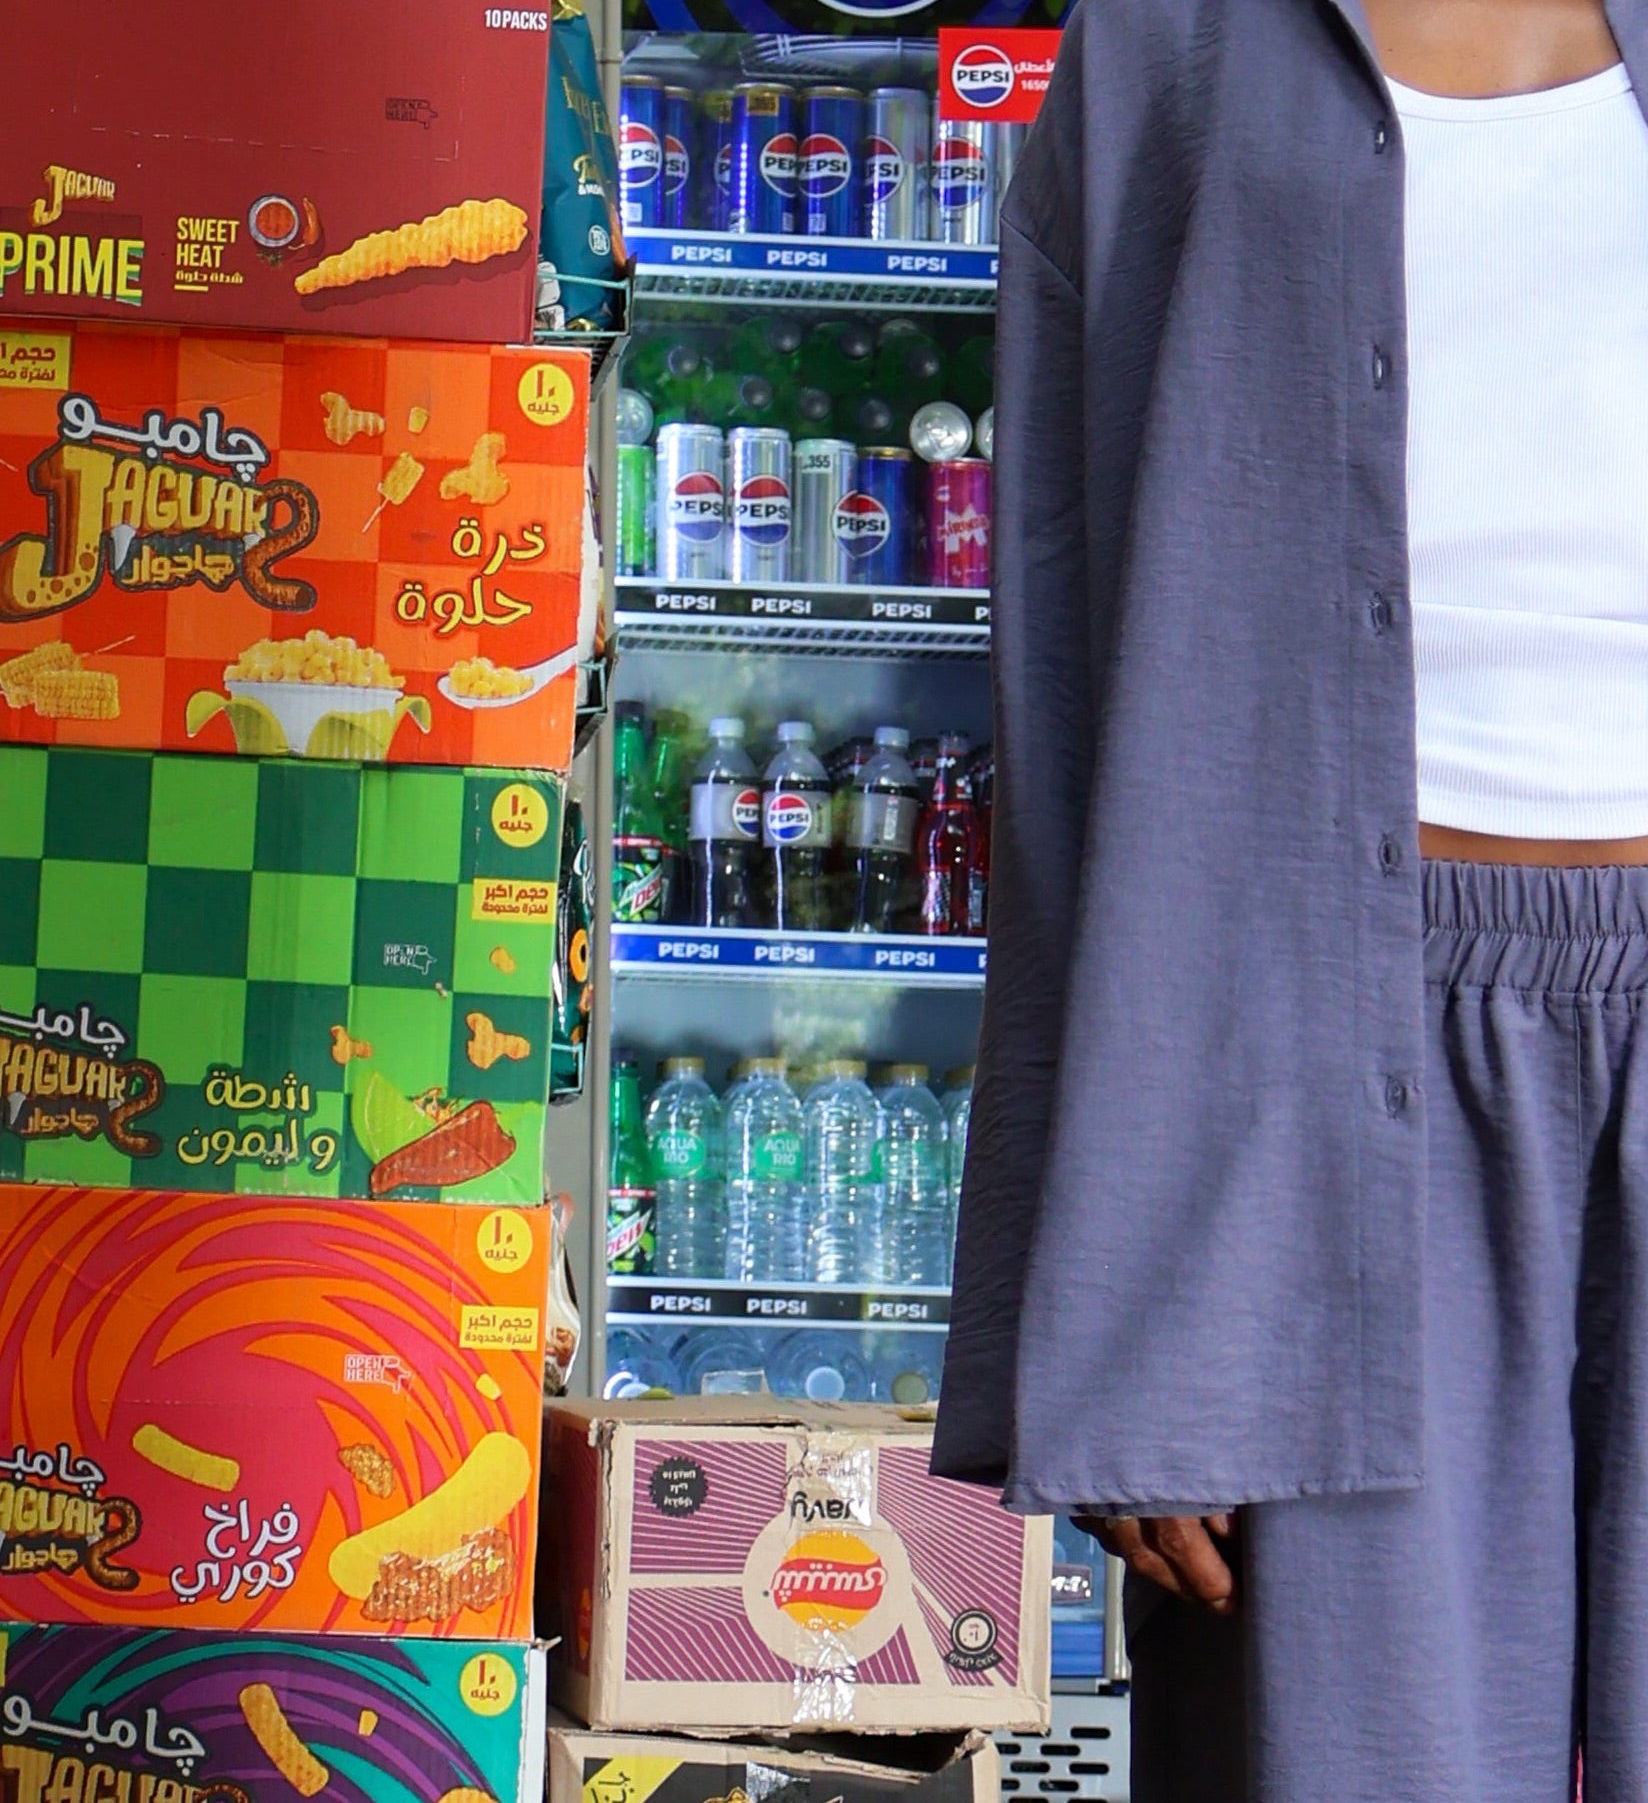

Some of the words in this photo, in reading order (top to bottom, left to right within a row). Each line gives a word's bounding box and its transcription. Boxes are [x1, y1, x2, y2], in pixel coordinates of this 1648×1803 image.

[956, 69, 1011, 84] PEPSI
[32, 165, 116, 226] JAGUAR
[177, 217, 239, 244] SWEET
[0, 231, 146, 304] PRIME
[176, 244, 223, 267] HEAT
[672, 246, 732, 263] PEPSI
[767, 250, 827, 268] PEPSI
[887, 255, 947, 273] PEPSI
[13, 443, 268, 610] JAGUAR
[453, 517, 547, 578] ذرة
[397, 579, 533, 633] حلوة
[656, 594, 716, 610] PEPSI
[751, 597, 811, 614] PEPSI
[872, 603, 931, 619] PEPSI
[769, 812, 810, 826] PEPSI
[658, 942, 719, 960] PEPSI
[754, 946, 815, 962] PEPSI
[875, 950, 936, 968] PEPSI
[657, 1137, 696, 1153] AQUA
[650, 1295, 711, 1313] PEPSI
[746, 1298, 807, 1314] PEPSI
[868, 1302, 928, 1320] PEPSI
[499, 1314, 533, 1330] حجم
[346, 1369, 380, 1381] HERE
[204, 1500, 299, 1559] فراخ
[172, 1546, 301, 1603] كوري
